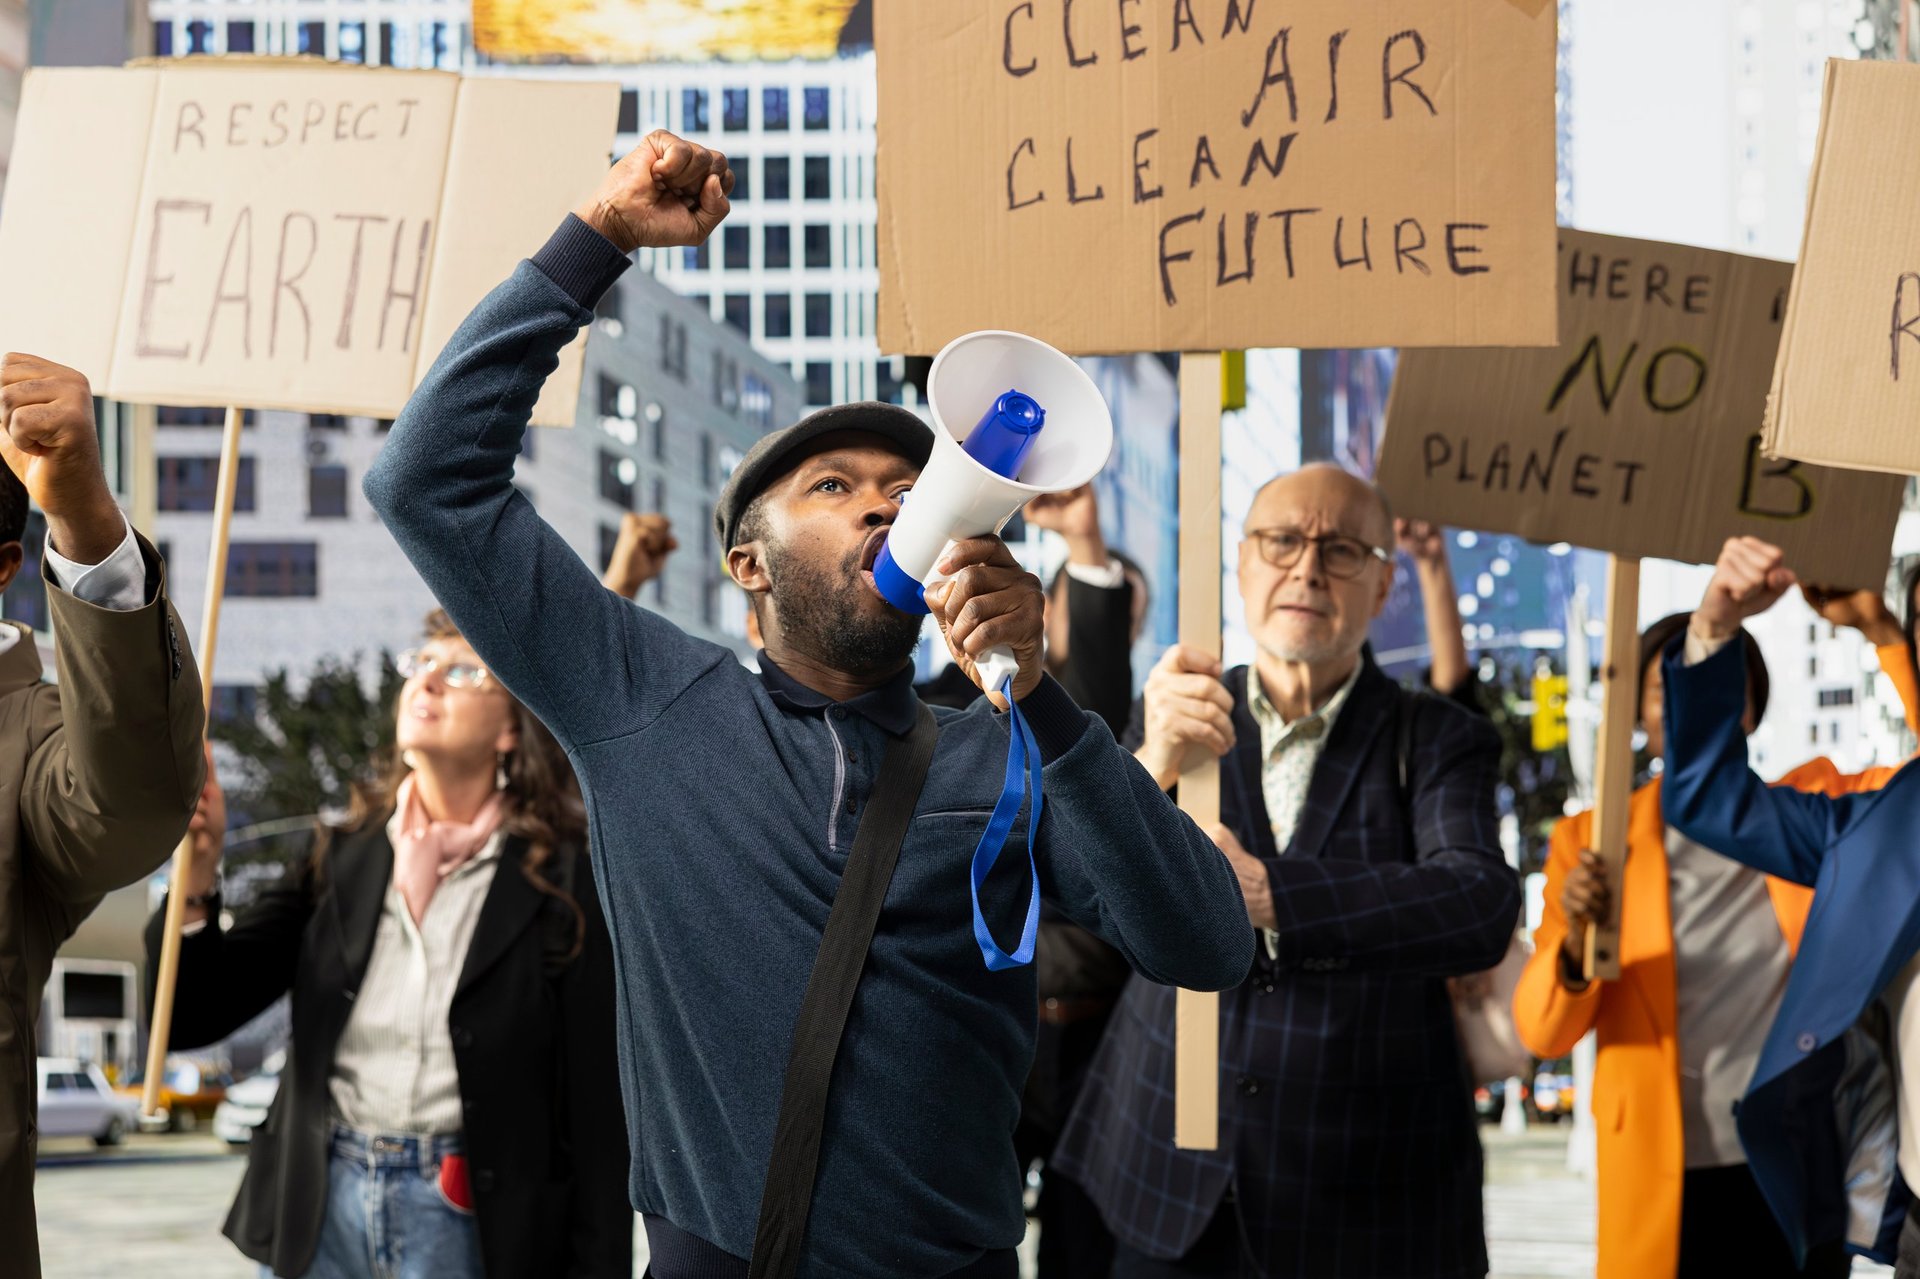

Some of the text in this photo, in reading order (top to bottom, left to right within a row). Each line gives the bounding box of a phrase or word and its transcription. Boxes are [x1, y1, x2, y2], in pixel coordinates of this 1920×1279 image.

[1002, 0, 1254, 77] CLEAN
[1240, 26, 1437, 128] AIR
[174, 100, 420, 154] RESPECT
[1006, 128, 1299, 210] CLEAN
[136, 199, 431, 364] EARTH
[1158, 207, 1491, 307] FUTURE
[1557, 239, 1712, 315] HERE
[1546, 334, 1708, 414] NO
[1422, 426, 1815, 520] PLANET B
